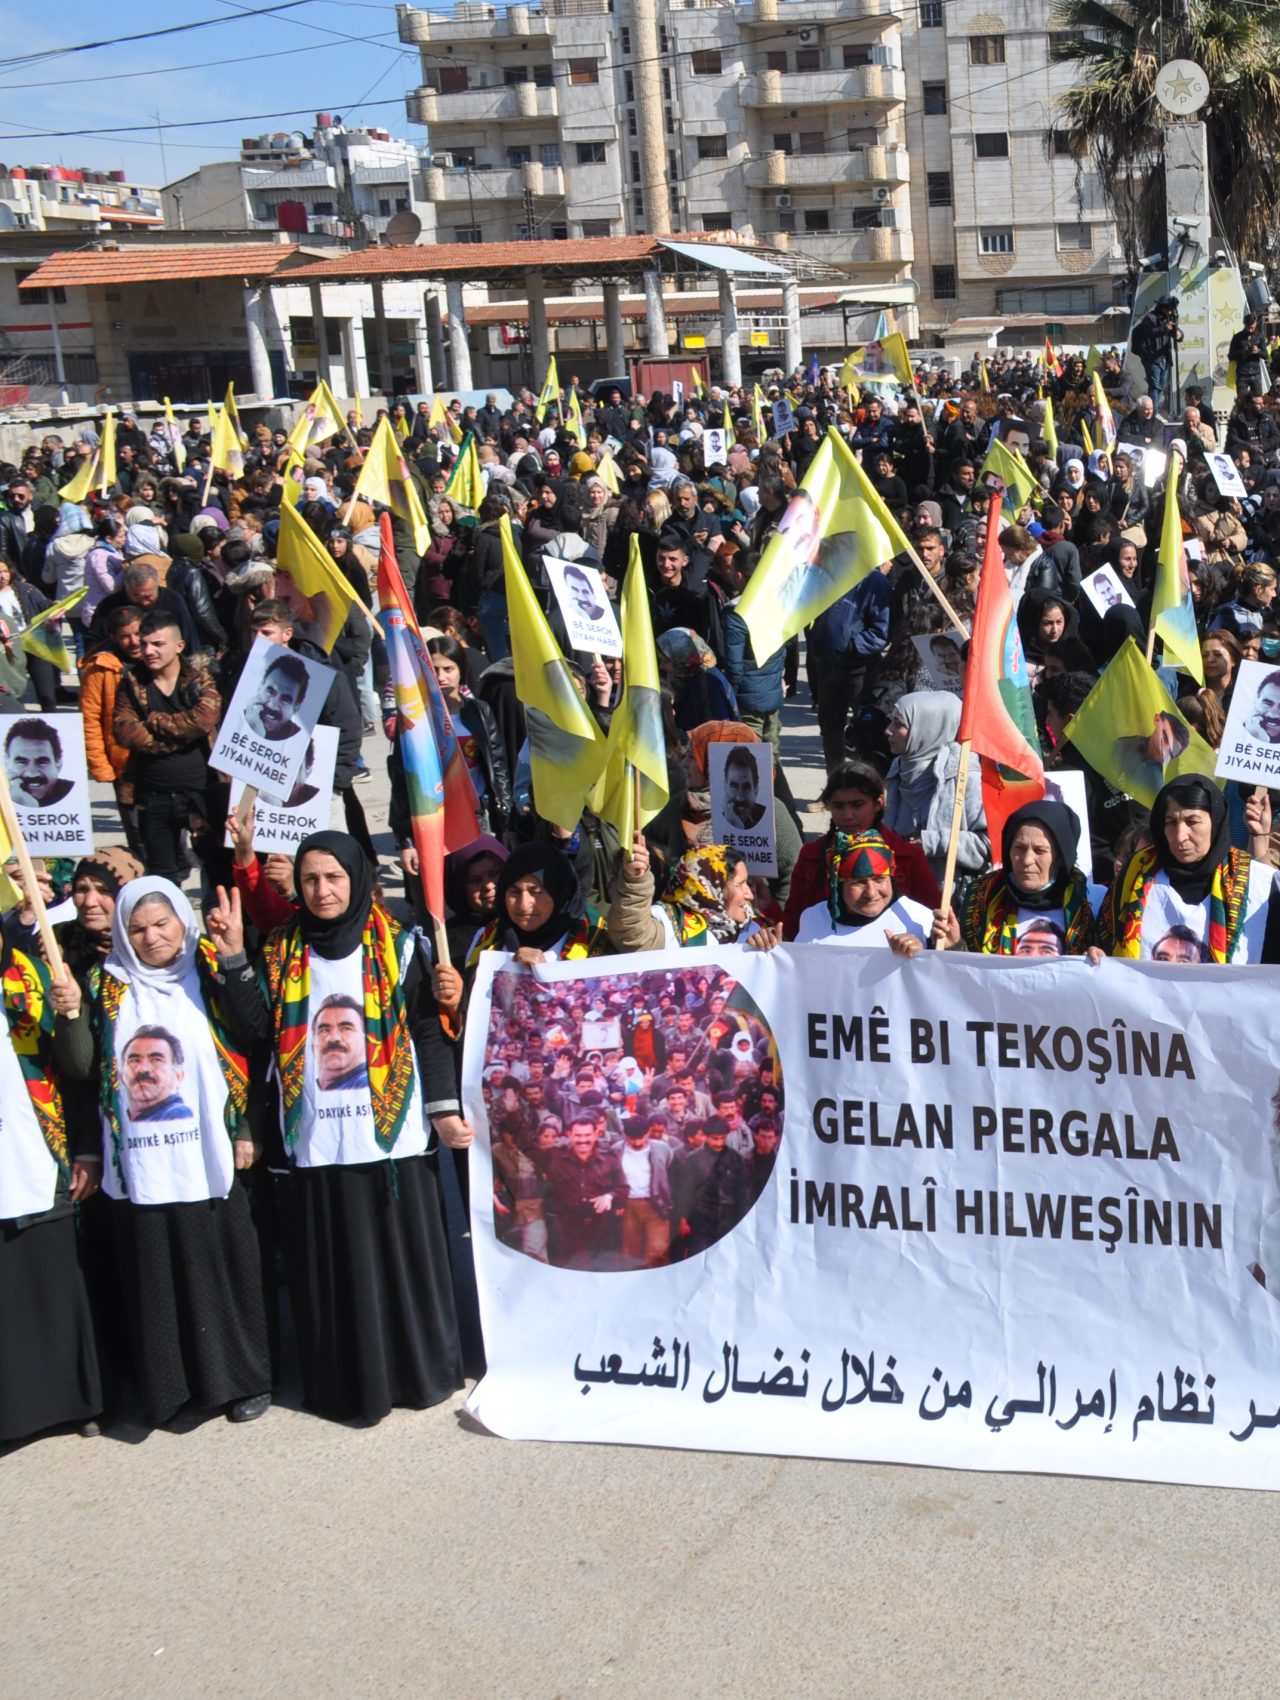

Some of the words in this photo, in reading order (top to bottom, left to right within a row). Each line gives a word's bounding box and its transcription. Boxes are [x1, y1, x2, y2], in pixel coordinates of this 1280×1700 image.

[218, 744, 254, 768] JIYAN
[254, 763, 288, 786] NABE
[230, 731, 249, 747] BÊ
[249, 741, 290, 768] SEROK
[1224, 755, 1262, 772] JIYAN
[1234, 743, 1253, 755] BÊ
[27, 813, 80, 826] SEROK
[44, 829, 86, 843] NABE
[254, 809, 265, 824] Ê
[268, 811, 318, 829] SEROK
[723, 833, 736, 847] BÊ
[738, 834, 770, 848] SEROK
[748, 851, 773, 863] NABE
[807, 1006, 891, 1063] EMÊ
[910, 1018, 950, 1066] BI
[966, 1018, 1196, 1085] TEKOŞÎNA
[812, 1098, 953, 1149] GELAN
[973, 1106, 1181, 1162] PERGALA
[789, 1167, 937, 1233] İMRALÎ
[955, 1187, 1223, 1254] HILWEŞÎNIN
[573, 1335, 691, 1396] الشعب
[702, 1340, 811, 1404] نضال
[820, 1347, 905, 1412] خلال
[918, 1366, 972, 1421] من
[984, 1360, 1118, 1434] إمرالي
[1132, 1365, 1217, 1442] نظام
